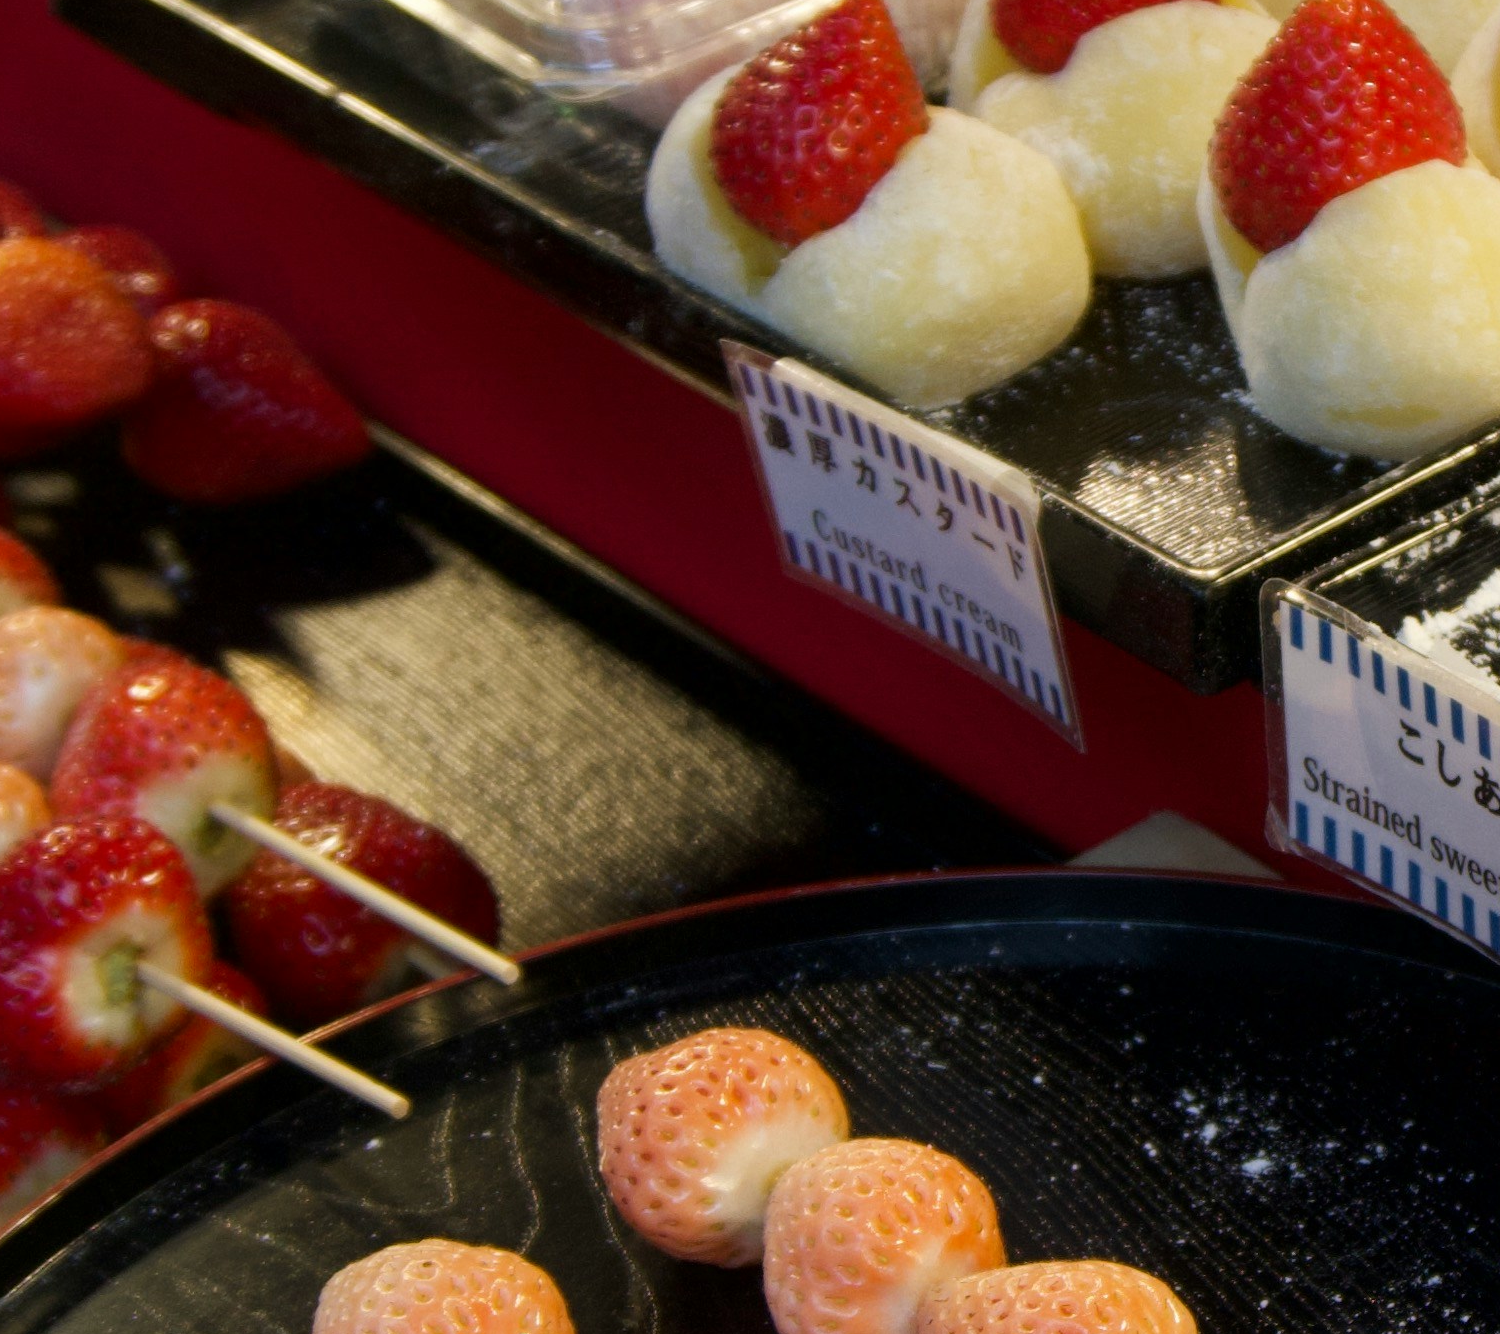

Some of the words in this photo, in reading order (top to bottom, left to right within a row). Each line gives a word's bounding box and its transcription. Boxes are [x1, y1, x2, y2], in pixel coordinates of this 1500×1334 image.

[812, 509, 929, 591] Custard
[938, 579, 1024, 653] cream
[1303, 756, 1422, 851] Strained
